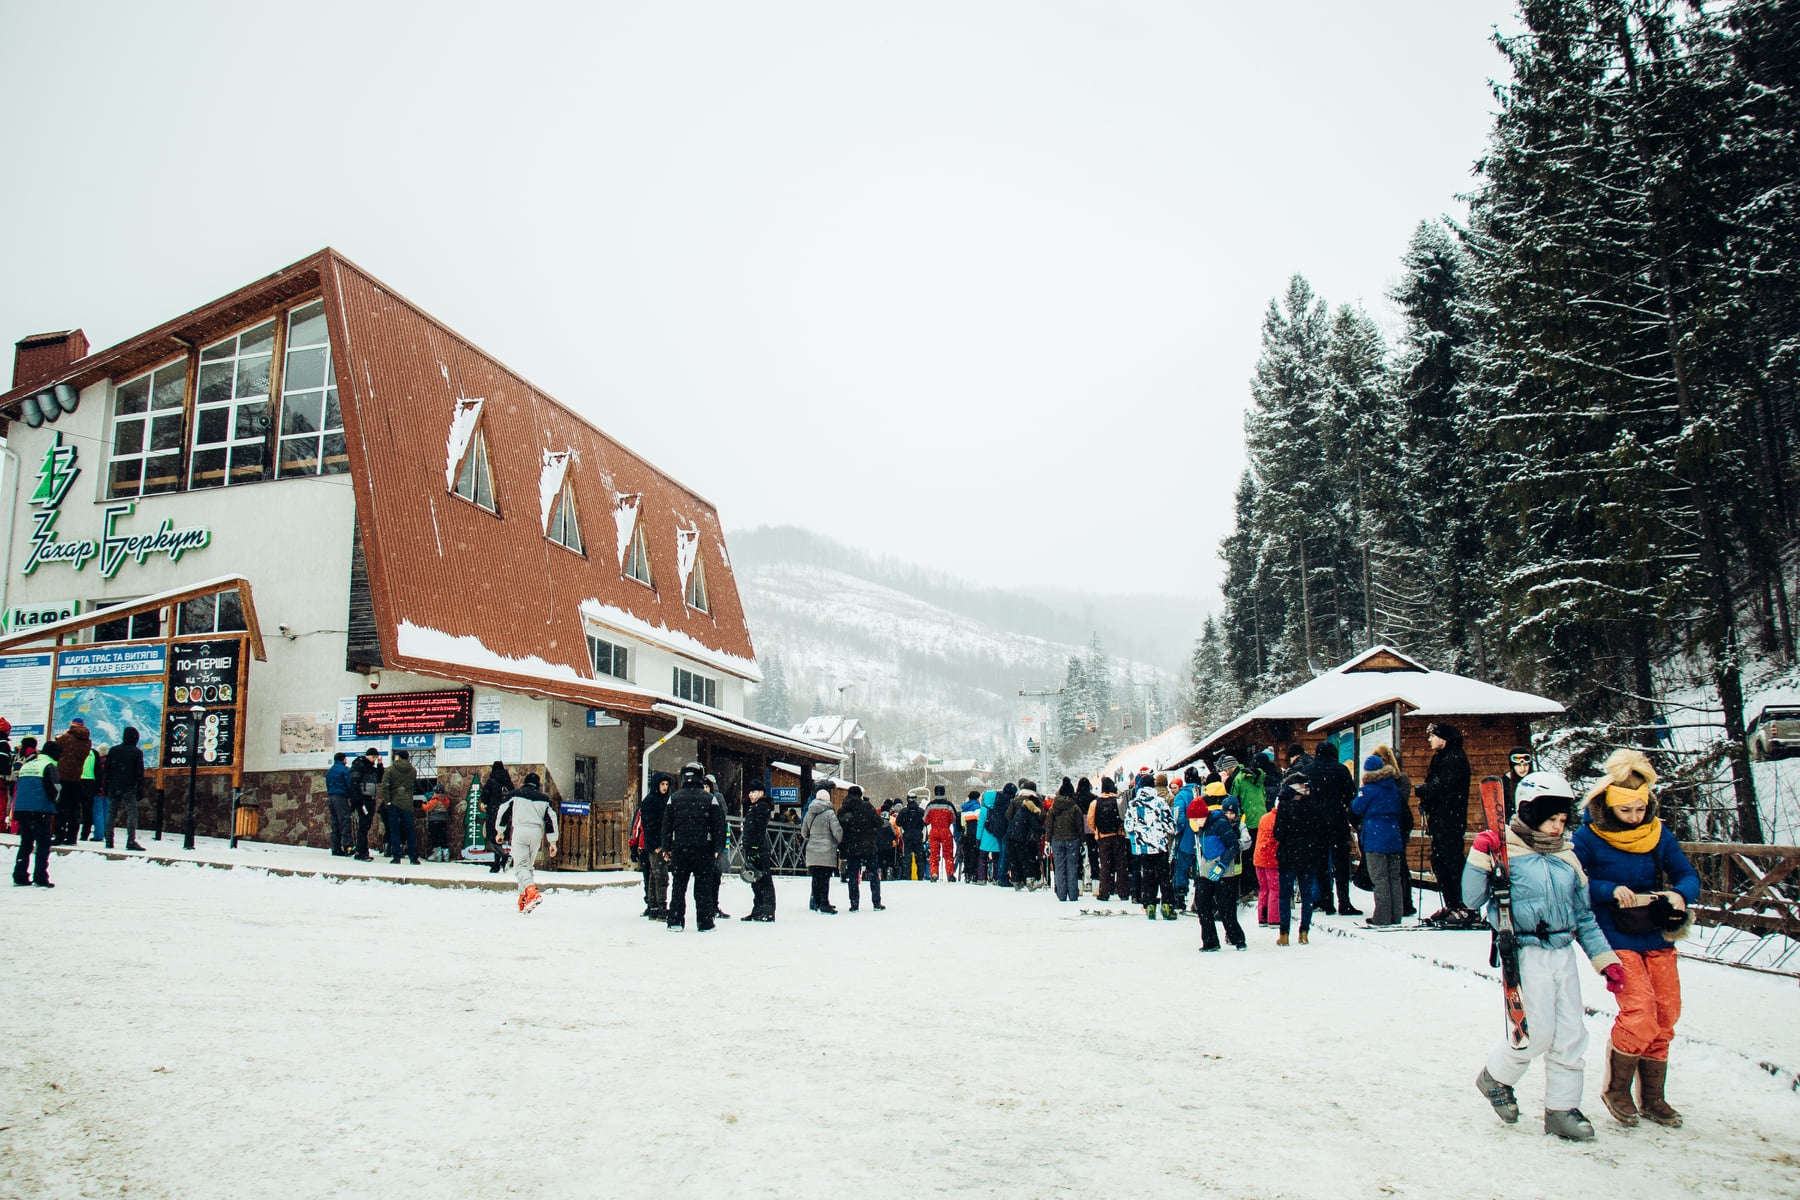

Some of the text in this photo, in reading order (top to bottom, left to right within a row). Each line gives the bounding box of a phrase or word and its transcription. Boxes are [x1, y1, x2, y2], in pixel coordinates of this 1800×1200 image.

[22, 504, 210, 578] Захар Беркут
[15, 610, 71, 625] кафе
[65, 651, 159, 664] КАРТА ТРАС ТА ВИТЯГІВ
[176, 657, 232, 671] ПО-ПЕРШЕ!
[400, 736, 427, 744] КАСА
[780, 789, 797, 797] ВХІД
